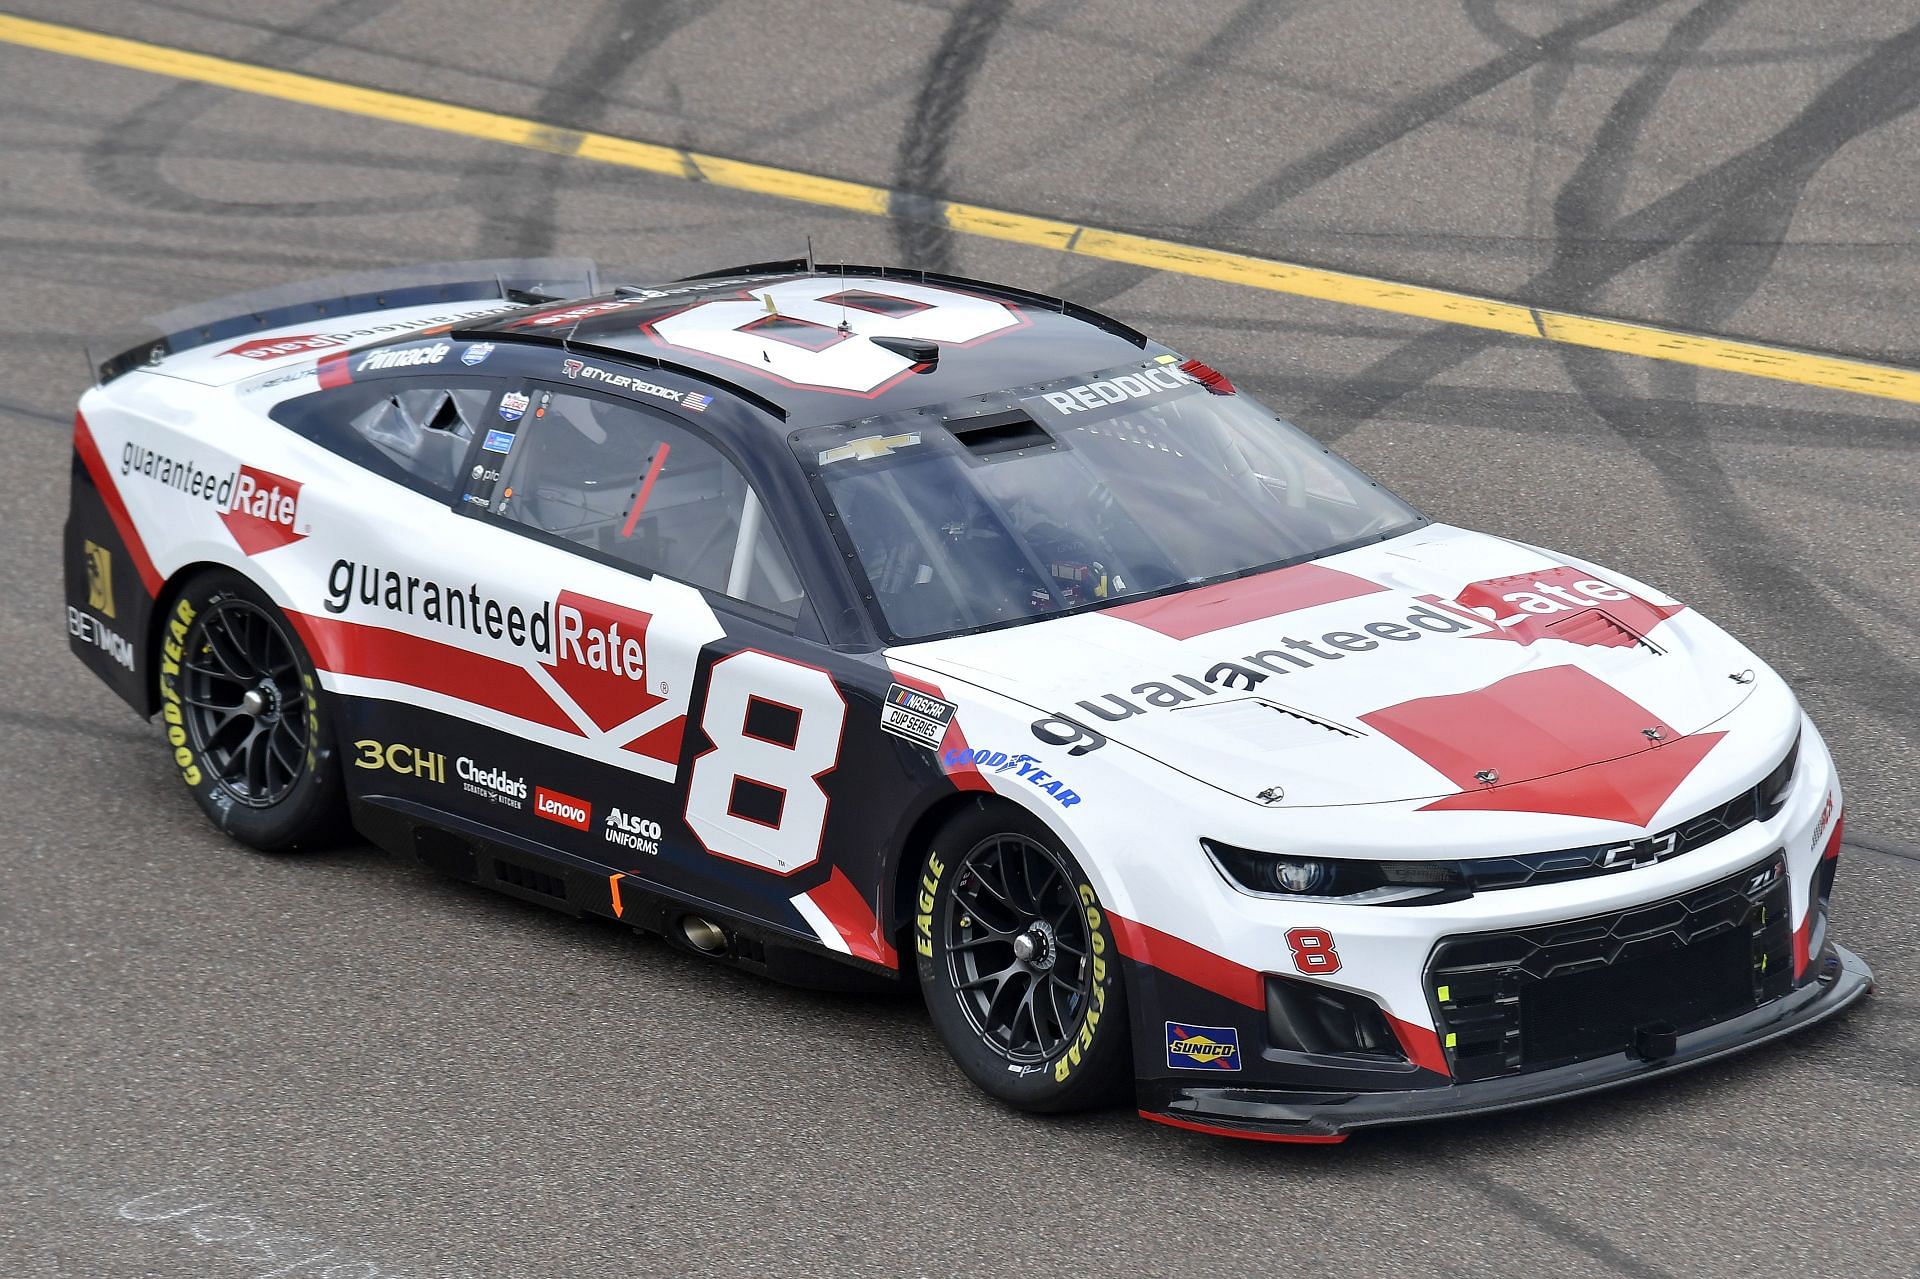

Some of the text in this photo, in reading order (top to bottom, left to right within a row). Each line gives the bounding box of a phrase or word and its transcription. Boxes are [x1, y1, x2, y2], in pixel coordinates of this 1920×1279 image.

[356, 342, 450, 371] Pinnacle
[645, 277, 1028, 396] 8
[1041, 363, 1191, 416] REDDICK
[121, 441, 296, 526] guaranteed Rate
[67, 605, 135, 672] BETMGM
[324, 558, 645, 682] guaranteed Rate
[890, 710, 938, 737] CUP SERIES
[907, 694, 946, 719] NASCAR
[353, 739, 446, 784] 3CHI
[456, 756, 528, 800] Cheddar's
[684, 648, 848, 877] 8
[463, 782, 522, 810] SCRATCH KITCHEN
[538, 793, 586, 823] Lenovo
[605, 828, 659, 856] UNIFORMS
[606, 807, 662, 841] ALSCO
[917, 850, 945, 959] EAGLE
[1284, 926, 1343, 976] 8
[1172, 1041, 1233, 1056] SUNOCO
